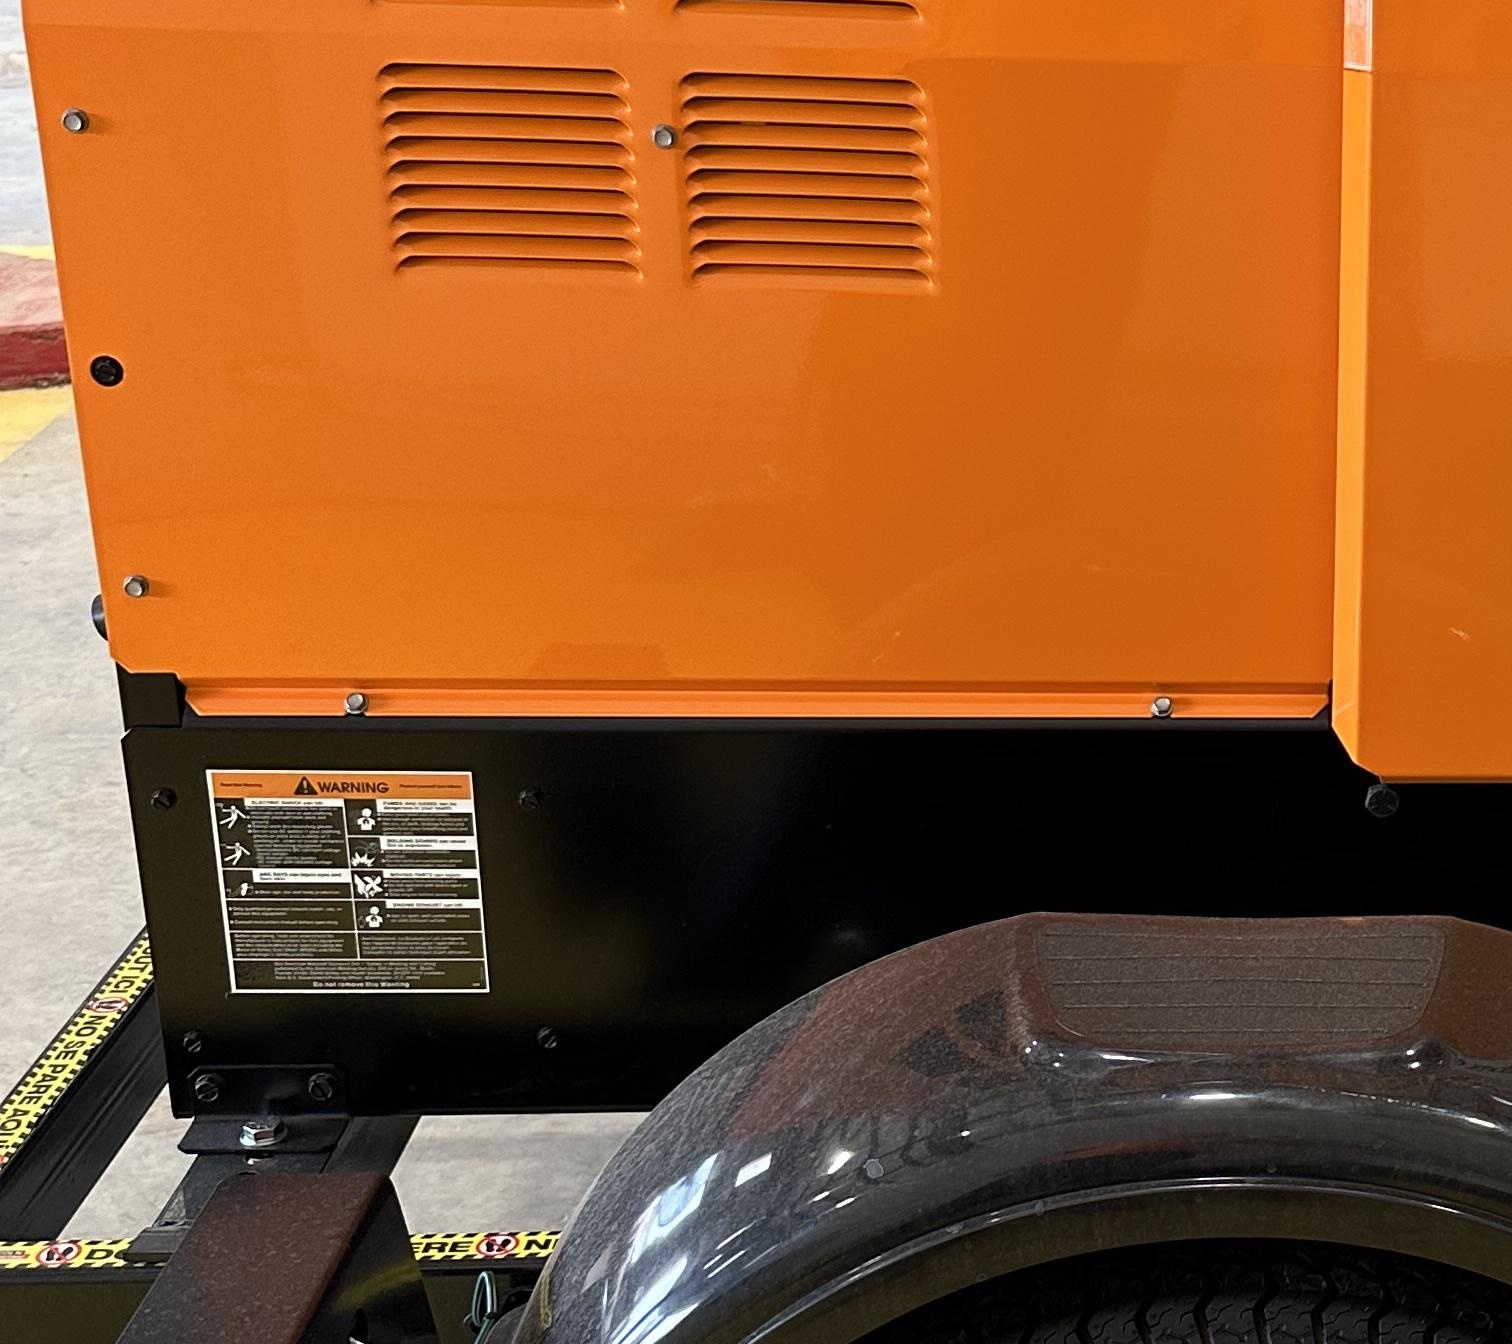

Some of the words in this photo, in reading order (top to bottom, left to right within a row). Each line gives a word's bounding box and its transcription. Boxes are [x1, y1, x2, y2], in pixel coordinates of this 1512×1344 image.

[317, 781, 389, 794] WARNING
[74, 1015, 107, 1038] NO
[54, 1040, 86, 1060] SE
[18, 1063, 71, 1105] PARE
[524, 1239, 560, 1251] N
